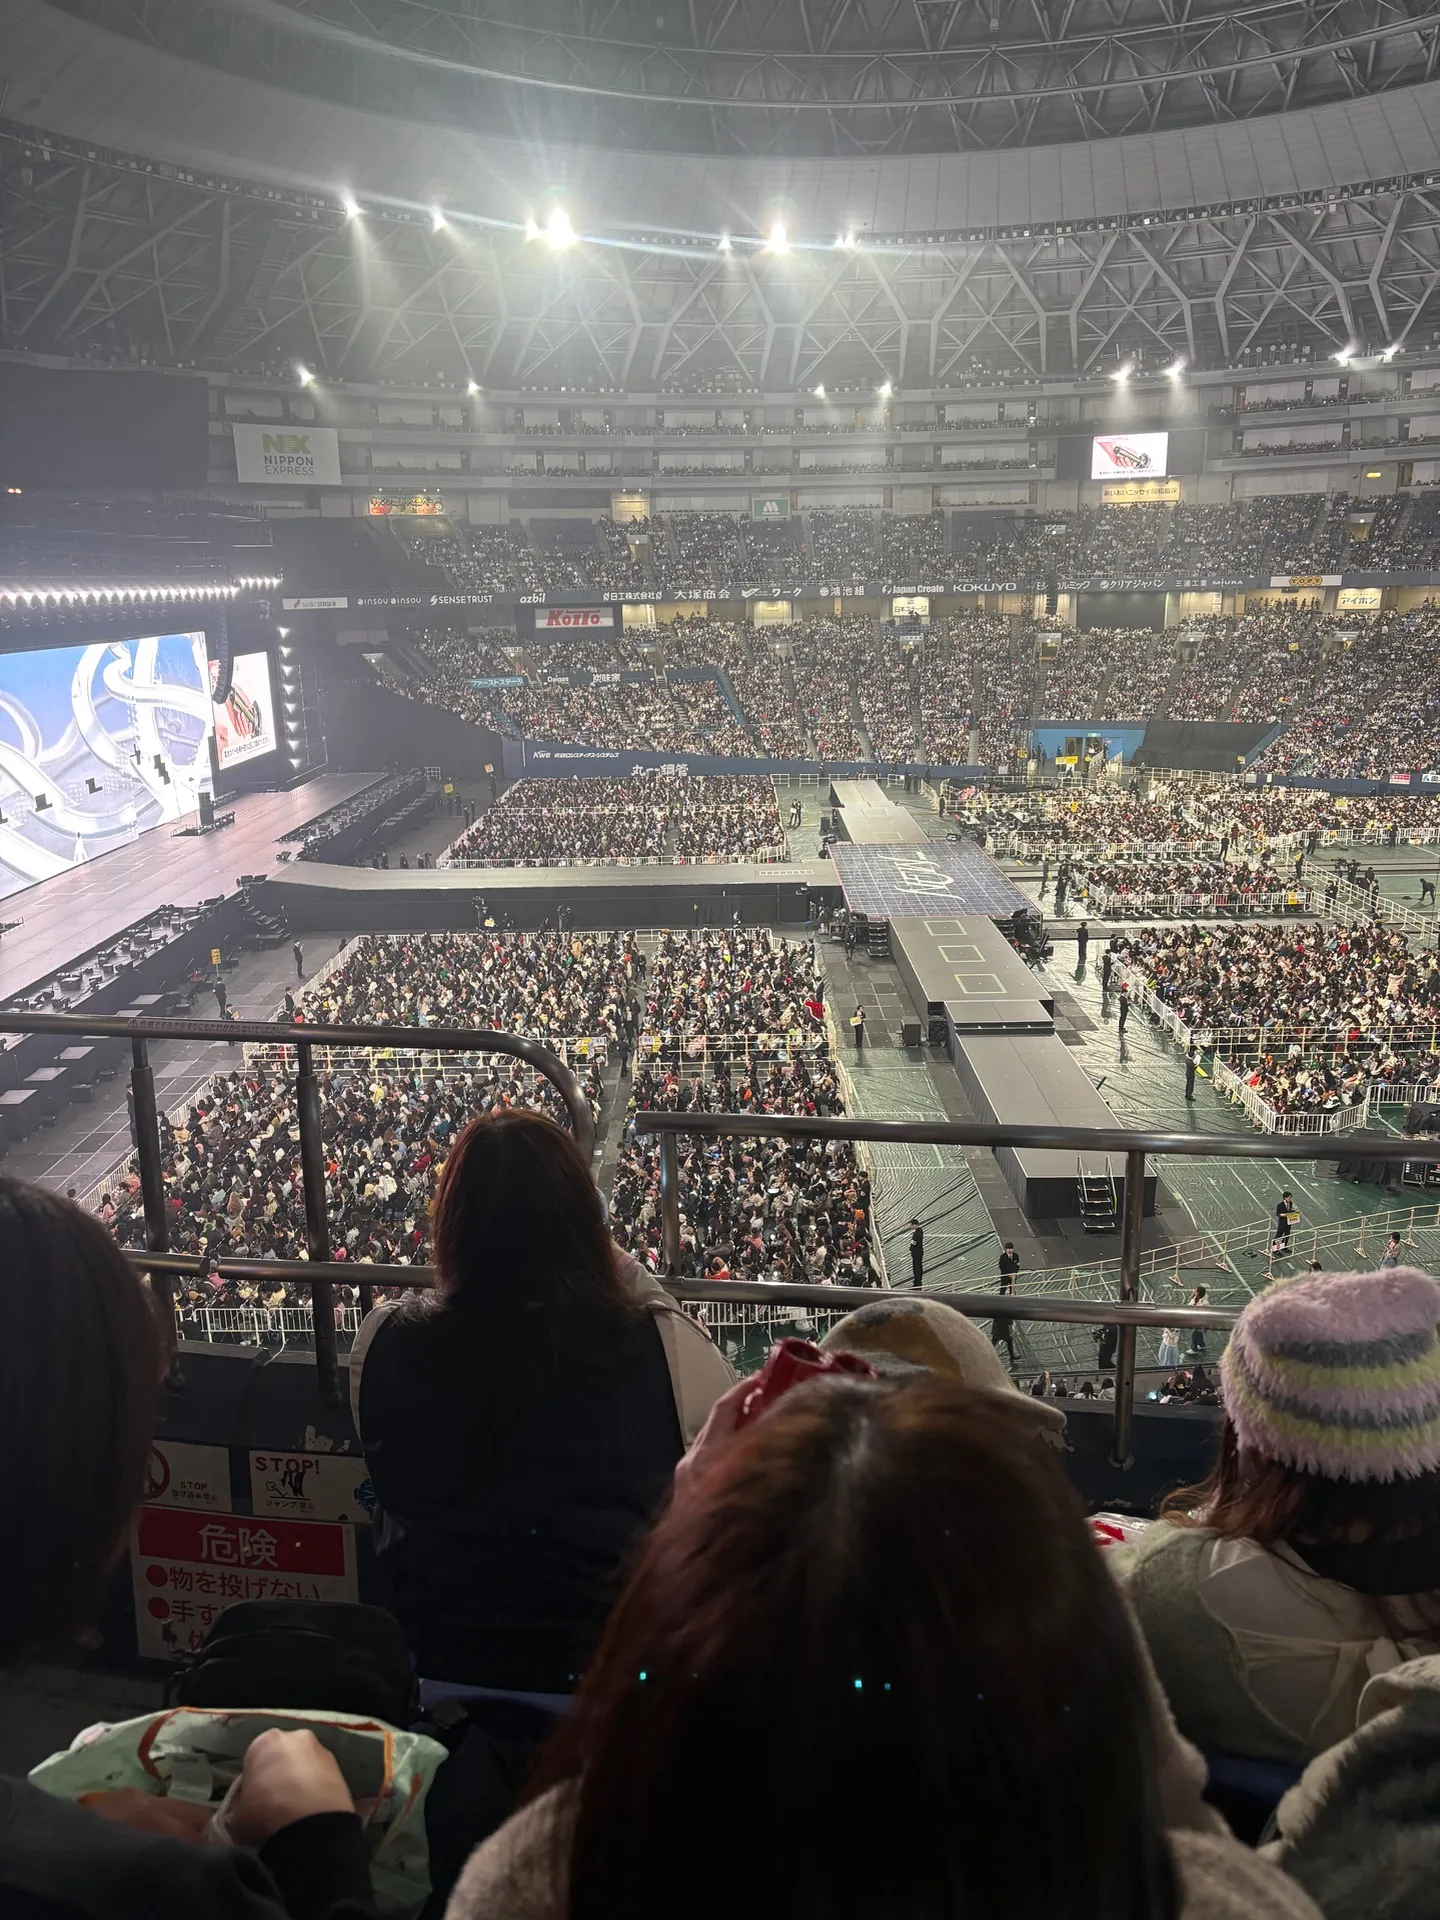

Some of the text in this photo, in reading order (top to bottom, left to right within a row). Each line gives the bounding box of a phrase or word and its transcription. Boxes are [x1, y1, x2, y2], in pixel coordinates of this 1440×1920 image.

[264, 455, 314, 466] NIPPON
[265, 465, 315, 476] EXPRESS
[892, 584, 945, 594] Japan Create
[953, 582, 1017, 592] KOKUYO
[1110, 579, 1166, 589] クリアジャパン
[520, 593, 546, 604] azbil
[610, 591, 656, 600] 日工株式会社
[674, 588, 731, 600] 大塚商会
[1341, 596, 1378, 605] アイホン
[471, 677, 523, 687] ファーストステージ
[533, 750, 551, 759] KWE
[255, 1456, 321, 1475] STOP!
[180, 1480, 208, 1491] STOP
[198, 1522, 280, 1569] 危険
[169, 1565, 321, 1600] 物を投げない
